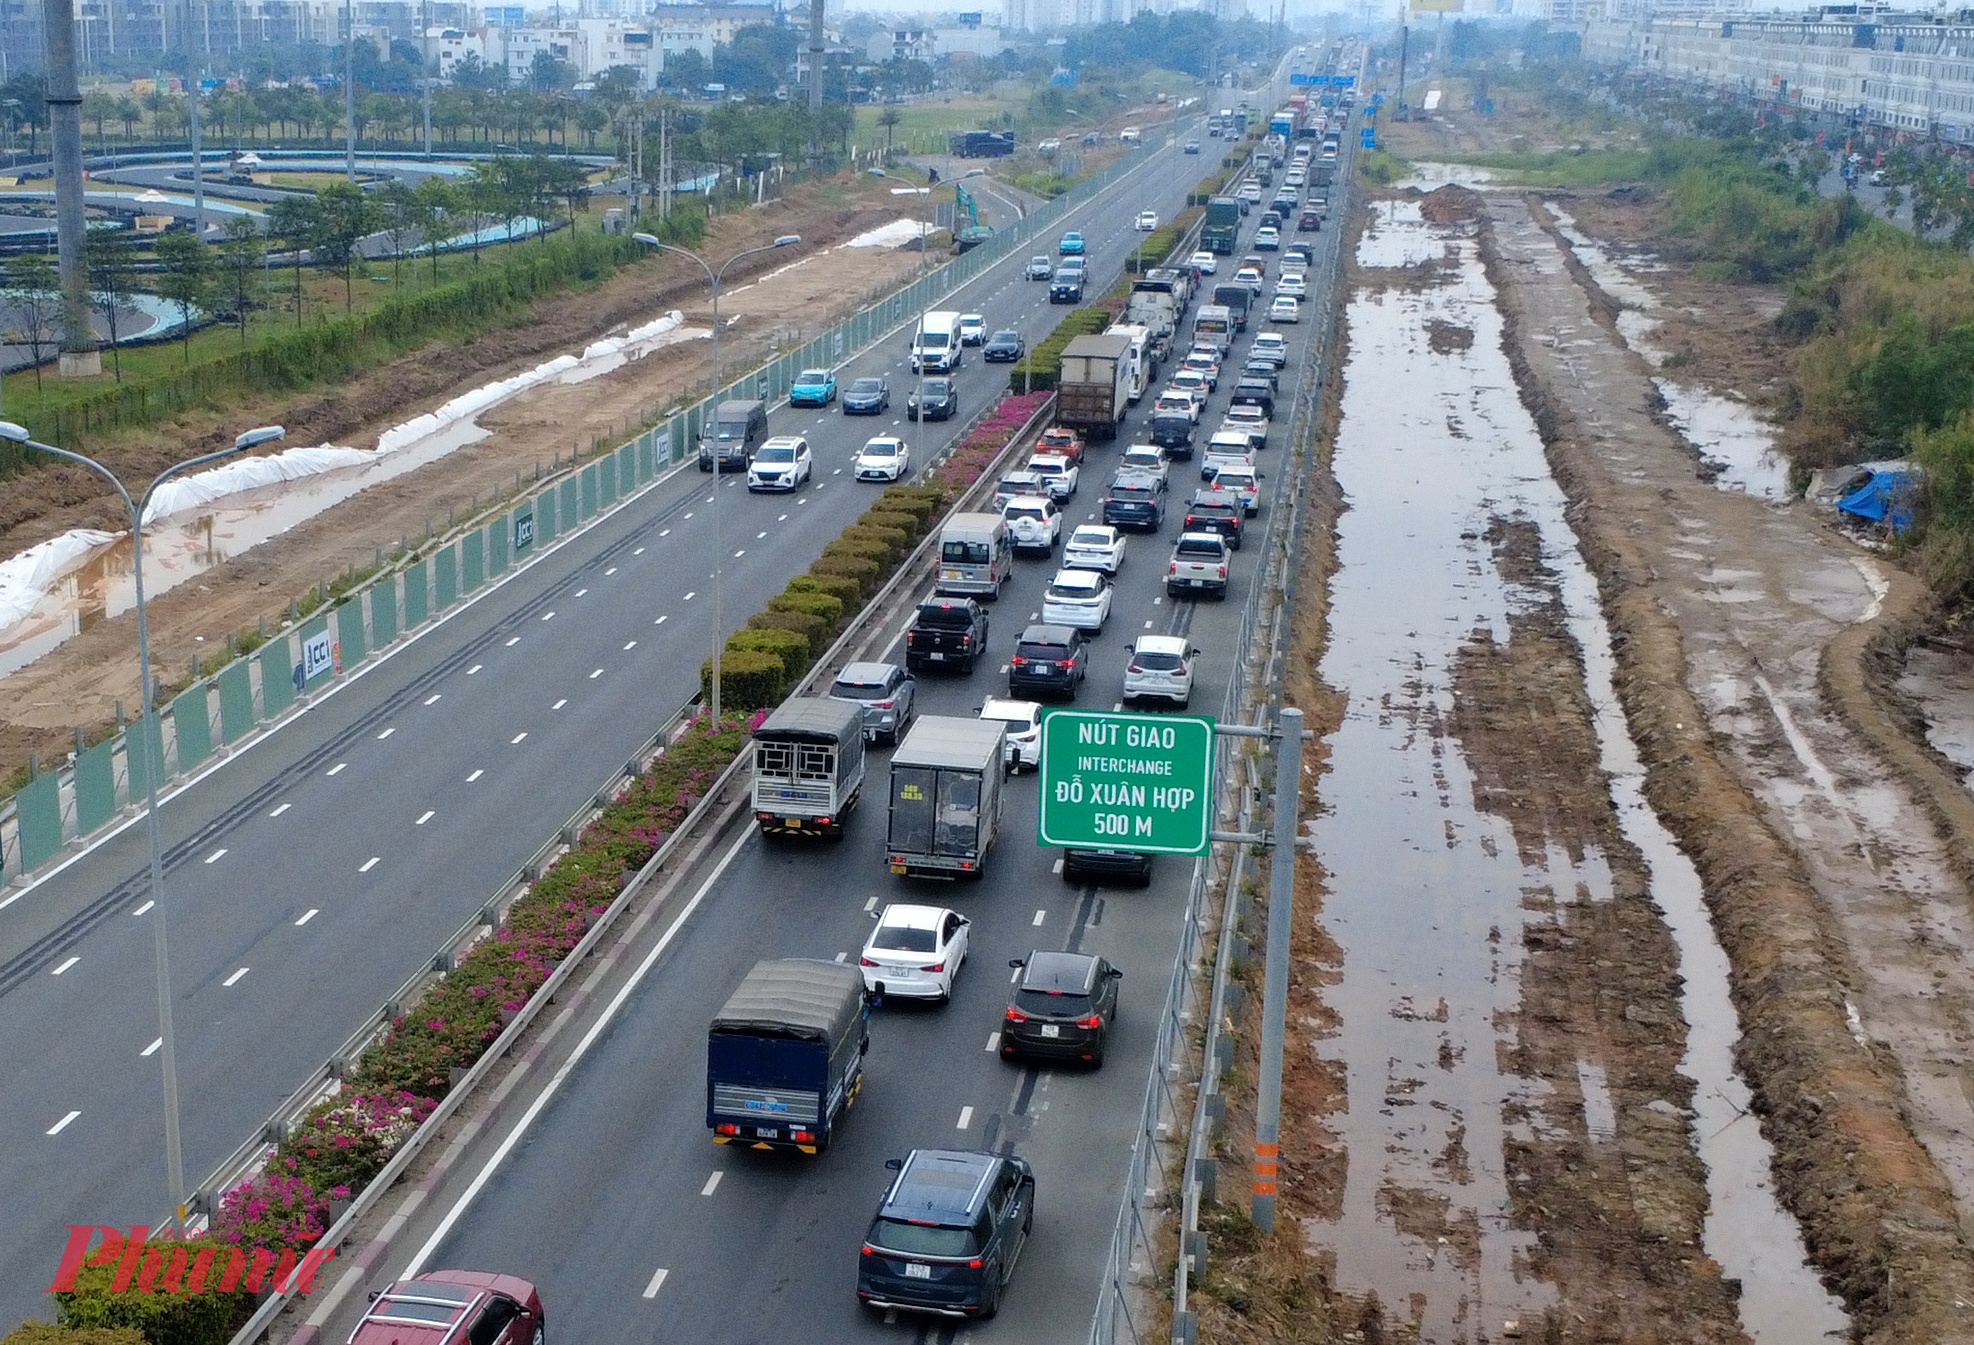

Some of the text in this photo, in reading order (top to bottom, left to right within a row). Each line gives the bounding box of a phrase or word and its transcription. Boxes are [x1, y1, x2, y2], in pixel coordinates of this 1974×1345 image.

[1078, 719, 1176, 750] NÚT GIAO
[1078, 756, 1173, 776] INTERCHANGE
[1055, 774, 1195, 813] ĐỖ XUÂN HỢP
[1094, 813, 1153, 837] 500 M
